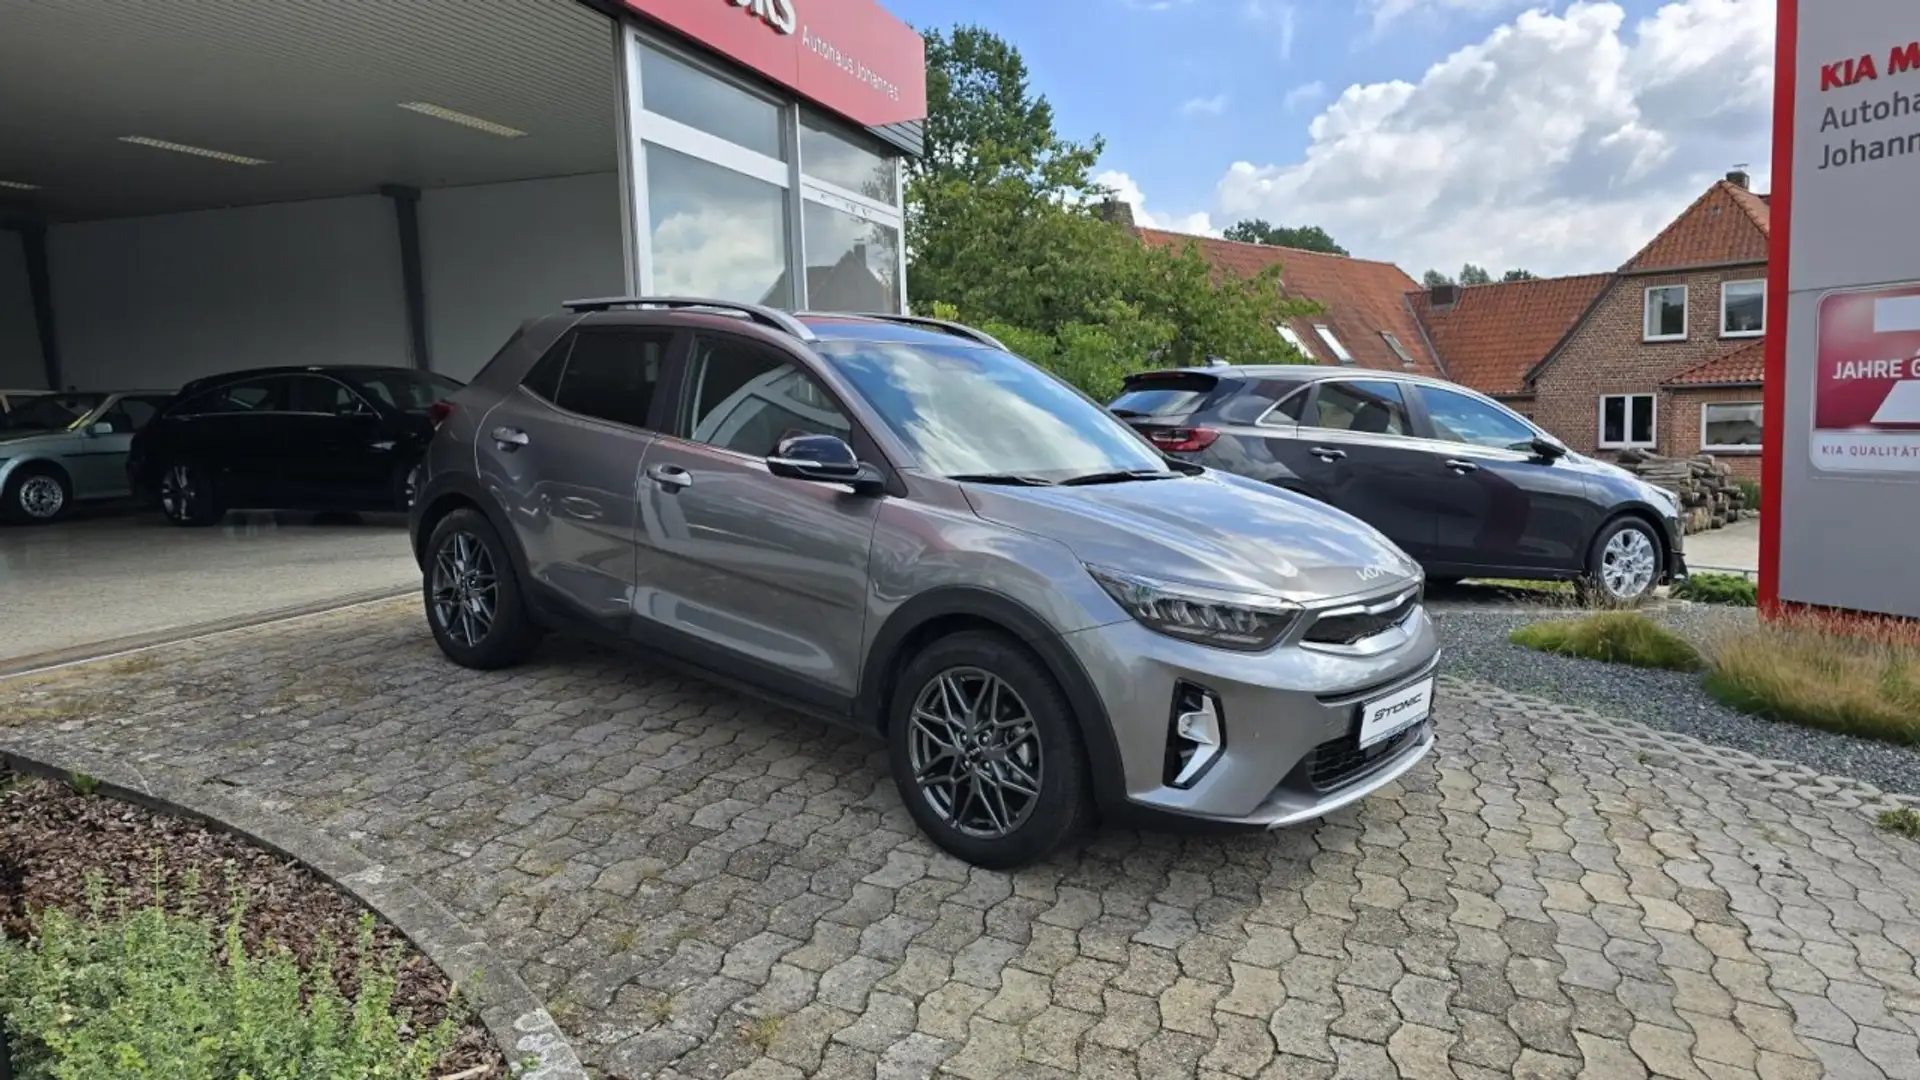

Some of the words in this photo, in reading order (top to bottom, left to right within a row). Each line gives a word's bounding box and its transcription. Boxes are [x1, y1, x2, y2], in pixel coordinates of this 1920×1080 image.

[802, 25, 853, 75] Autohaus
[857, 61, 899, 101] Johannes
[1820, 54, 1877, 91] KIA
[1818, 132, 1920, 169] Johann
[1832, 360, 1903, 380] JAHRE
[1822, 445, 1843, 456] KIA
[1372, 692, 1423, 723] STONIC
